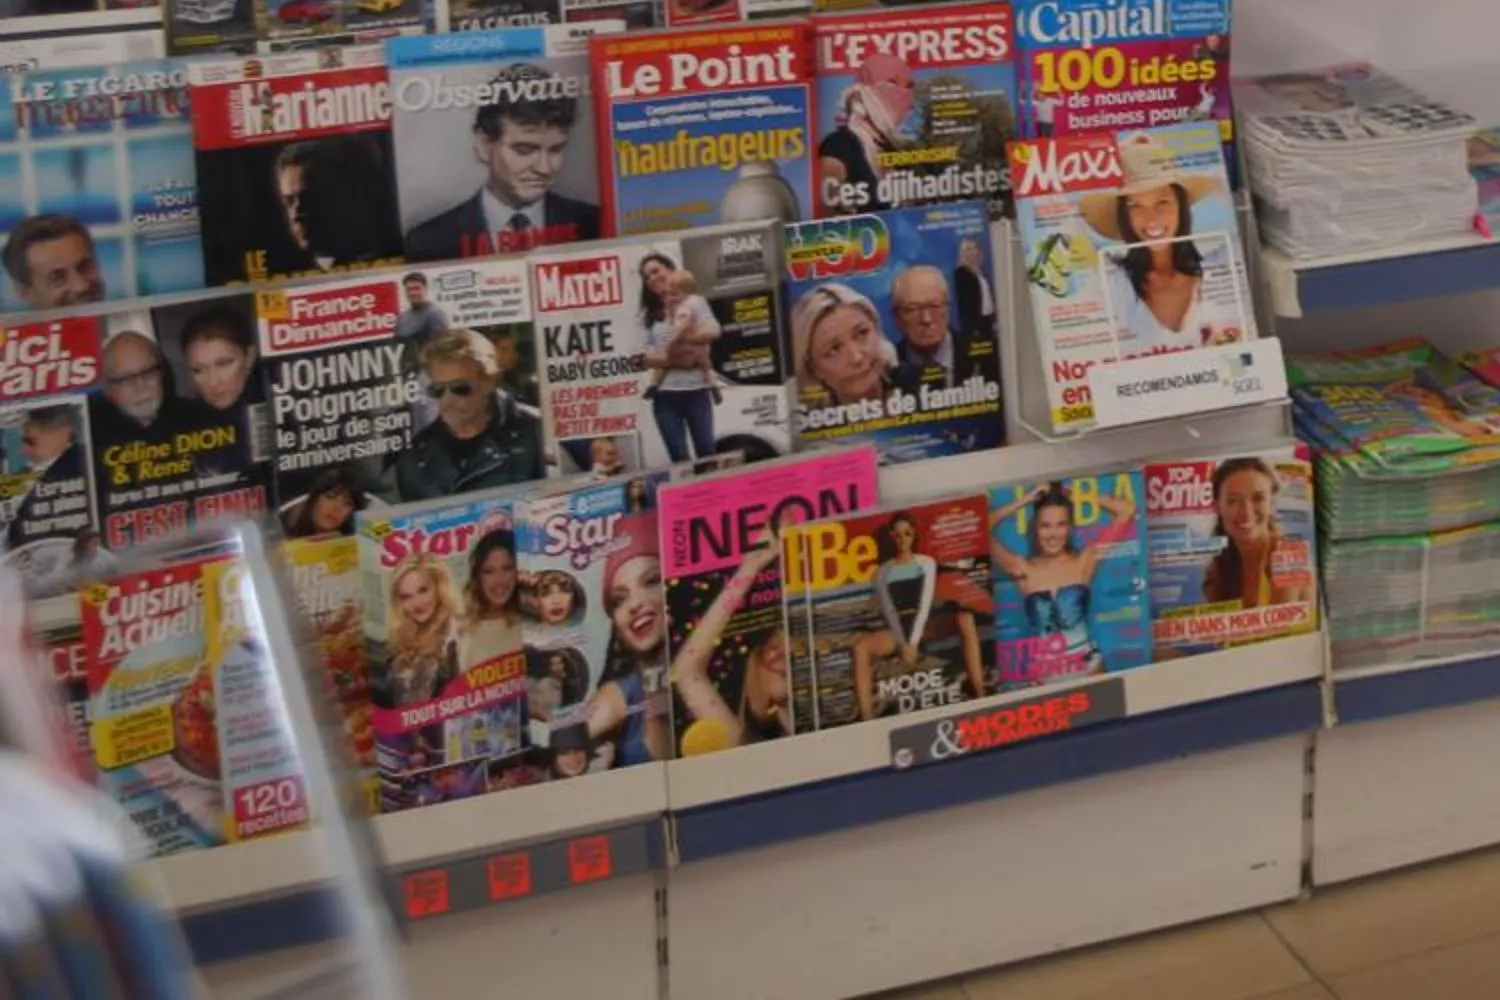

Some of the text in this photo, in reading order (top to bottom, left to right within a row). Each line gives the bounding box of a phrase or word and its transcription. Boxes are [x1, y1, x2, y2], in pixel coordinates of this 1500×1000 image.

[823, 24, 1009, 70] L'EXPRESS
[62, 70, 188, 99] FIGARO
[608, 61, 663, 97] Le
[671, 43, 797, 91] Point
[1035, 46, 1217, 93] 100 idées
[240, 78, 395, 137] Marianne
[1067, 107, 1189, 130] business pour
[1068, 88, 1177, 109] de nouveaux
[618, 126, 805, 178] naufrageurs
[1019, 141, 1123, 195] Maxi
[821, 163, 1011, 209] Ces djihadistes
[291, 290, 377, 321] France
[535, 256, 623, 311] MATCH
[272, 313, 398, 348] Dimanche
[543, 319, 614, 359] KATE
[0, 349, 97, 397] aris
[272, 344, 405, 395] JOHNNY
[546, 359, 589, 384] BABY
[1116, 368, 1220, 399] RECOMENDAMOS
[275, 374, 418, 425] Poignardé
[797, 394, 885, 429] Secrets
[887, 388, 917, 416] de
[920, 374, 1000, 412] famille
[104, 426, 236, 467] Céline DION
[276, 411, 412, 450] le jour de son
[113, 454, 193, 486] & René
[278, 436, 403, 472] anniversaire
[105, 501, 189, 550] C'EST
[380, 523, 477, 568] Star
[545, 512, 622, 556] Star
[688, 482, 861, 565] NEON
[101, 573, 207, 626] Cuisine
[1188, 612, 1227, 638] DANS
[878, 668, 944, 697] MODE
[400, 708, 437, 728] TOUT
[439, 698, 466, 718] SUR
[467, 692, 484, 709] LA
[930, 692, 1090, 760] & MODES
[240, 780, 299, 816] 120
